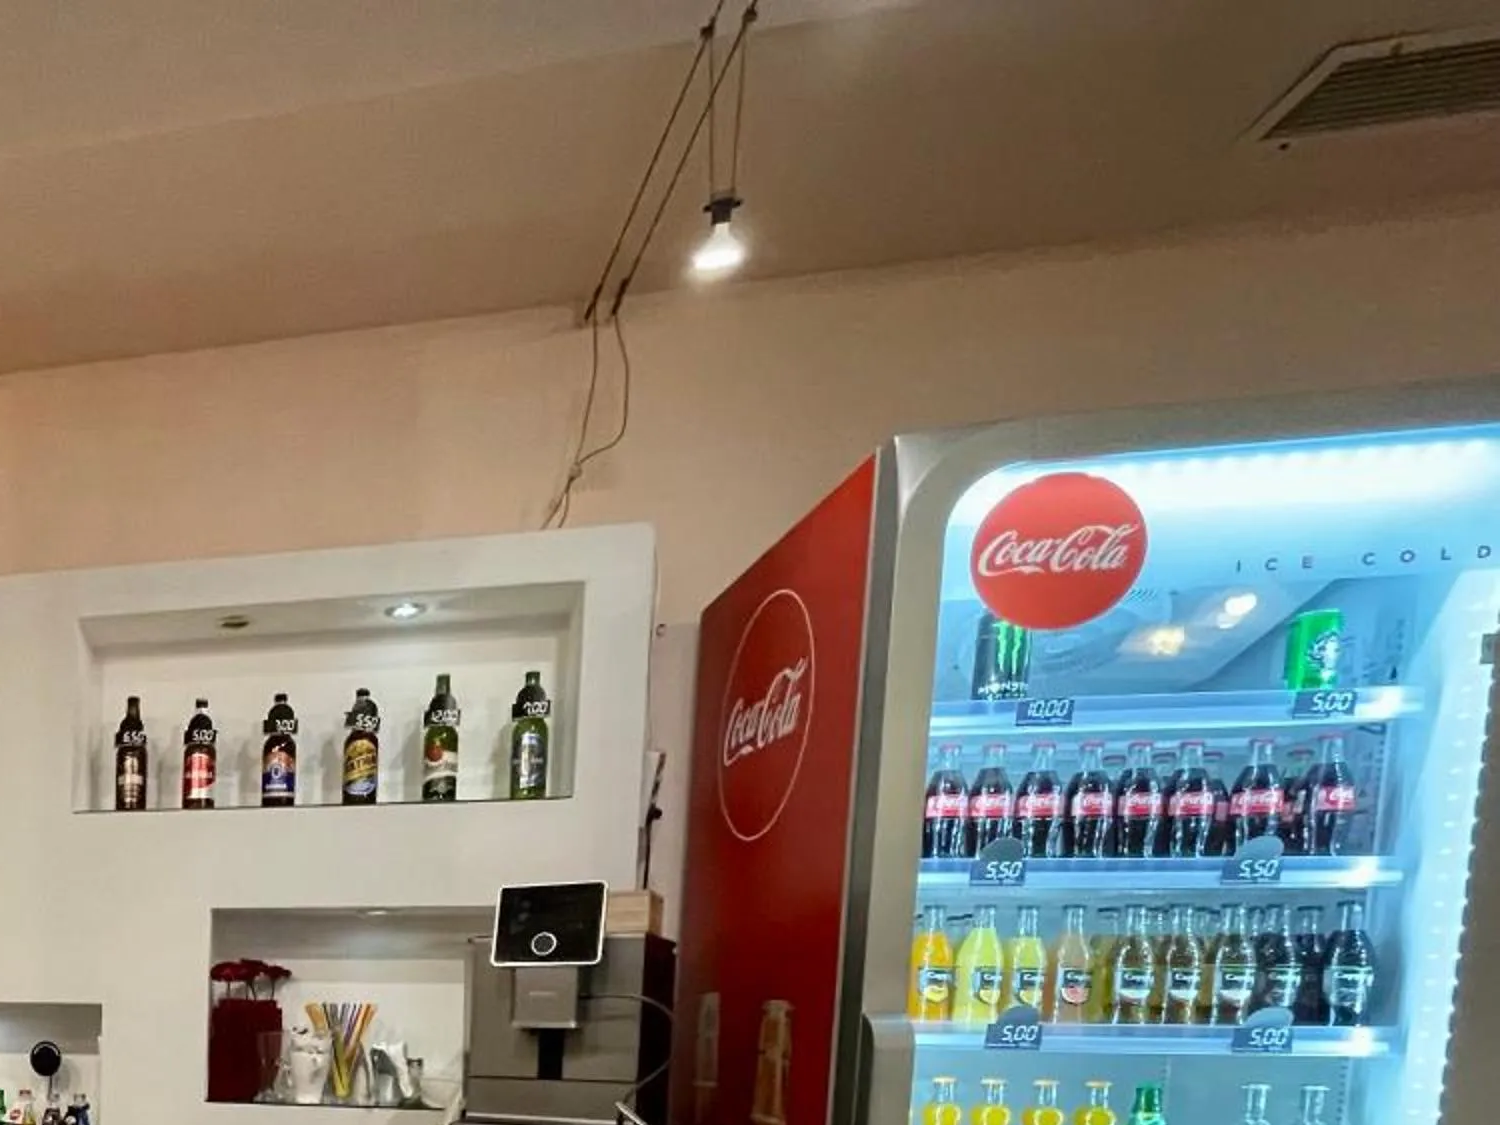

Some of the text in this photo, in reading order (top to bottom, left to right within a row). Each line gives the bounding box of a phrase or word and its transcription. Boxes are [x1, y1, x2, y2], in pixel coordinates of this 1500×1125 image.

[977, 523, 1140, 577] Coca-Cola
[1235, 545, 1492, 572] ICE COLD
